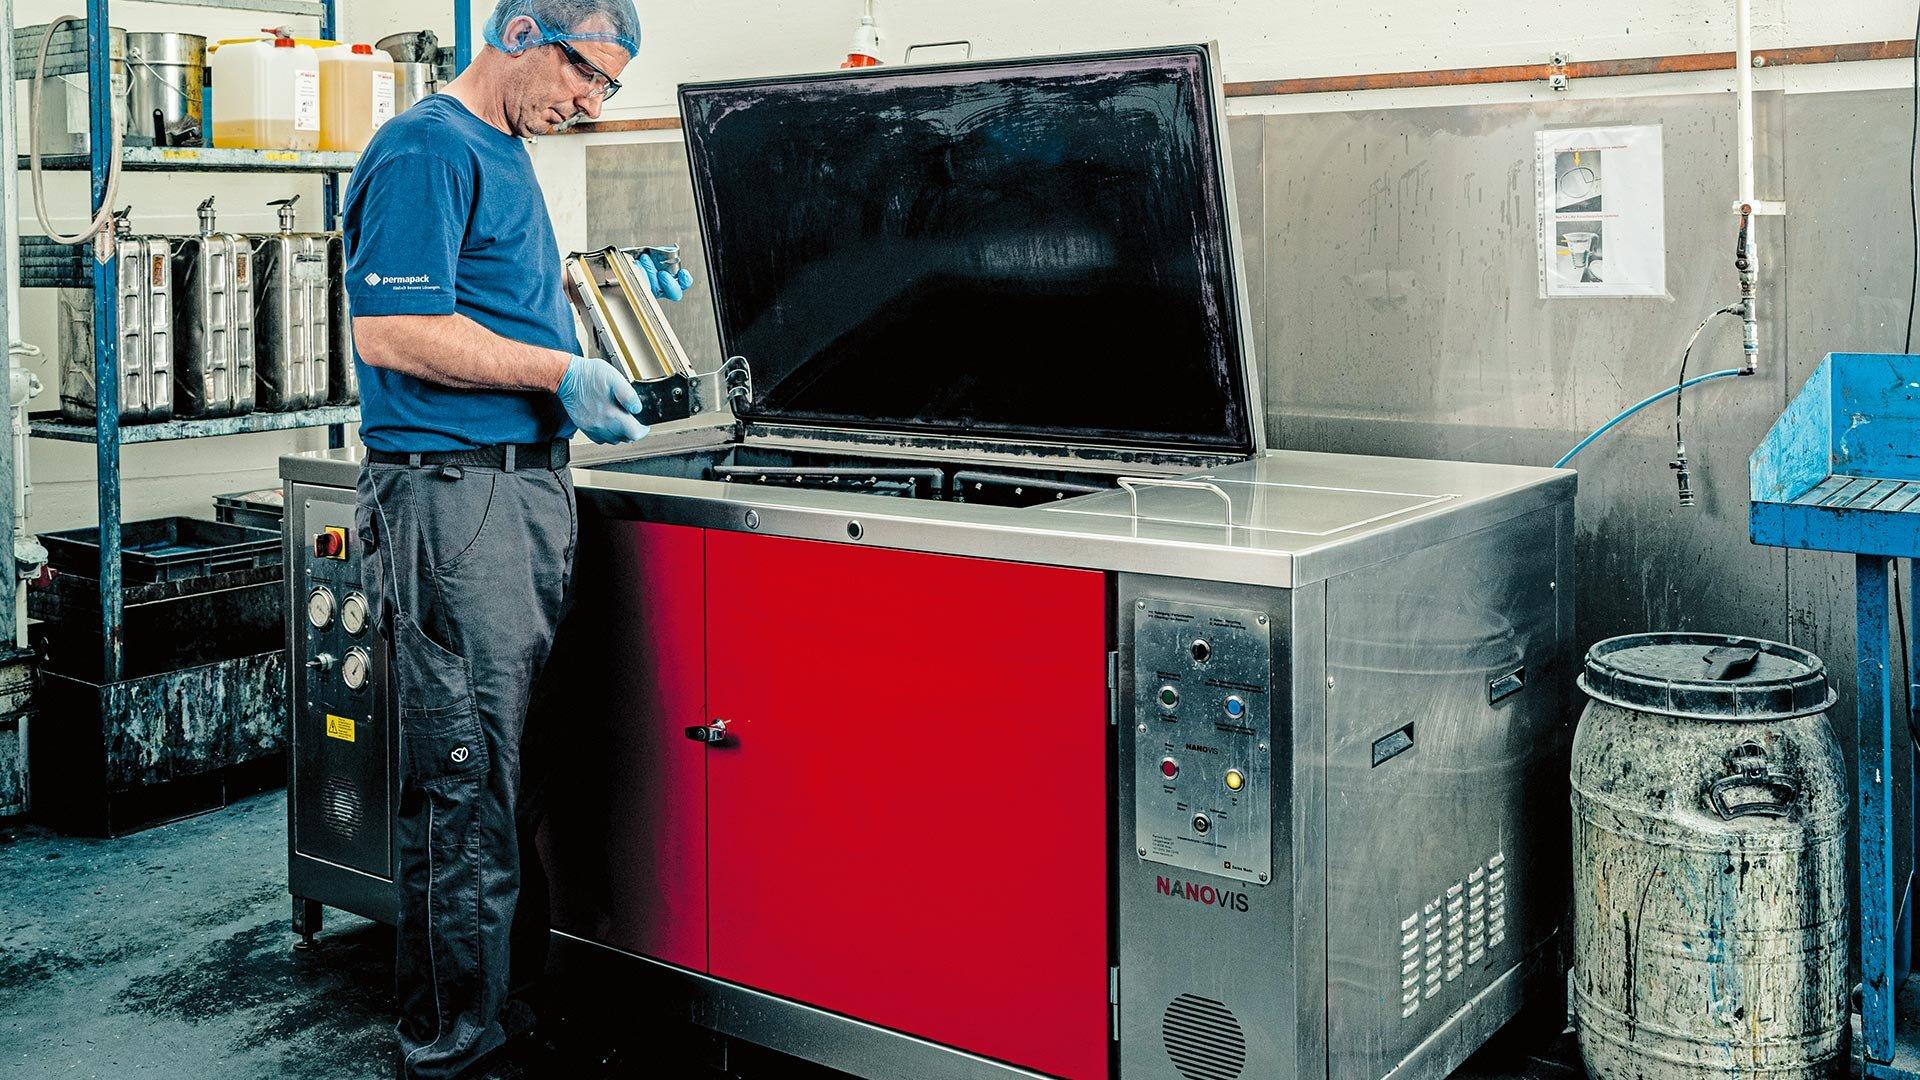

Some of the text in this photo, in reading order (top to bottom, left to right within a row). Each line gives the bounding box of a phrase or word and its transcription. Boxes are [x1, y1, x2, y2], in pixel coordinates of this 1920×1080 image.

[382, 274, 429, 285] permapack
[1185, 743, 1219, 755] NANOVIS
[1156, 875, 1249, 912] NANOVIS
